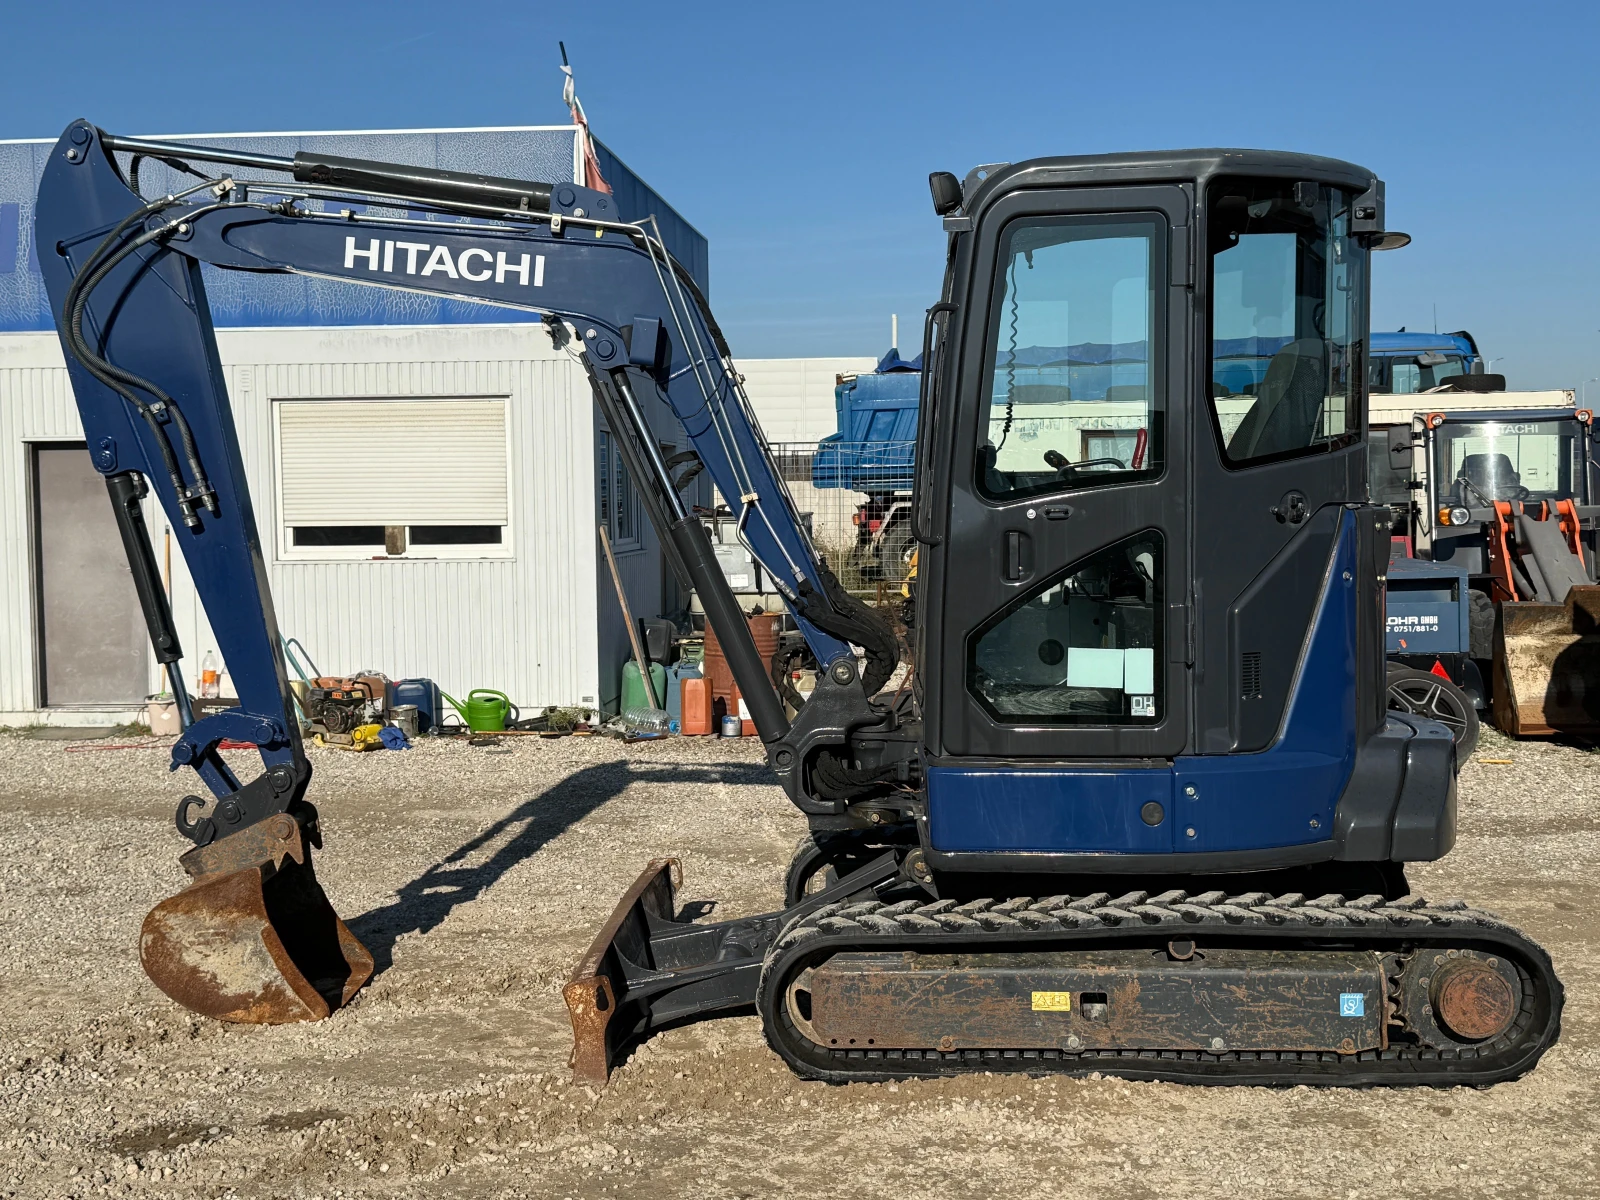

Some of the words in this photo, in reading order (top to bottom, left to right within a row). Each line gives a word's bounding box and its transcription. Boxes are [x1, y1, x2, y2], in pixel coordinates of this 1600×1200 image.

[344, 236, 546, 287] HITACHI
[1490, 424, 1539, 433] TACHI
[1386, 616, 1418, 625] OHR
